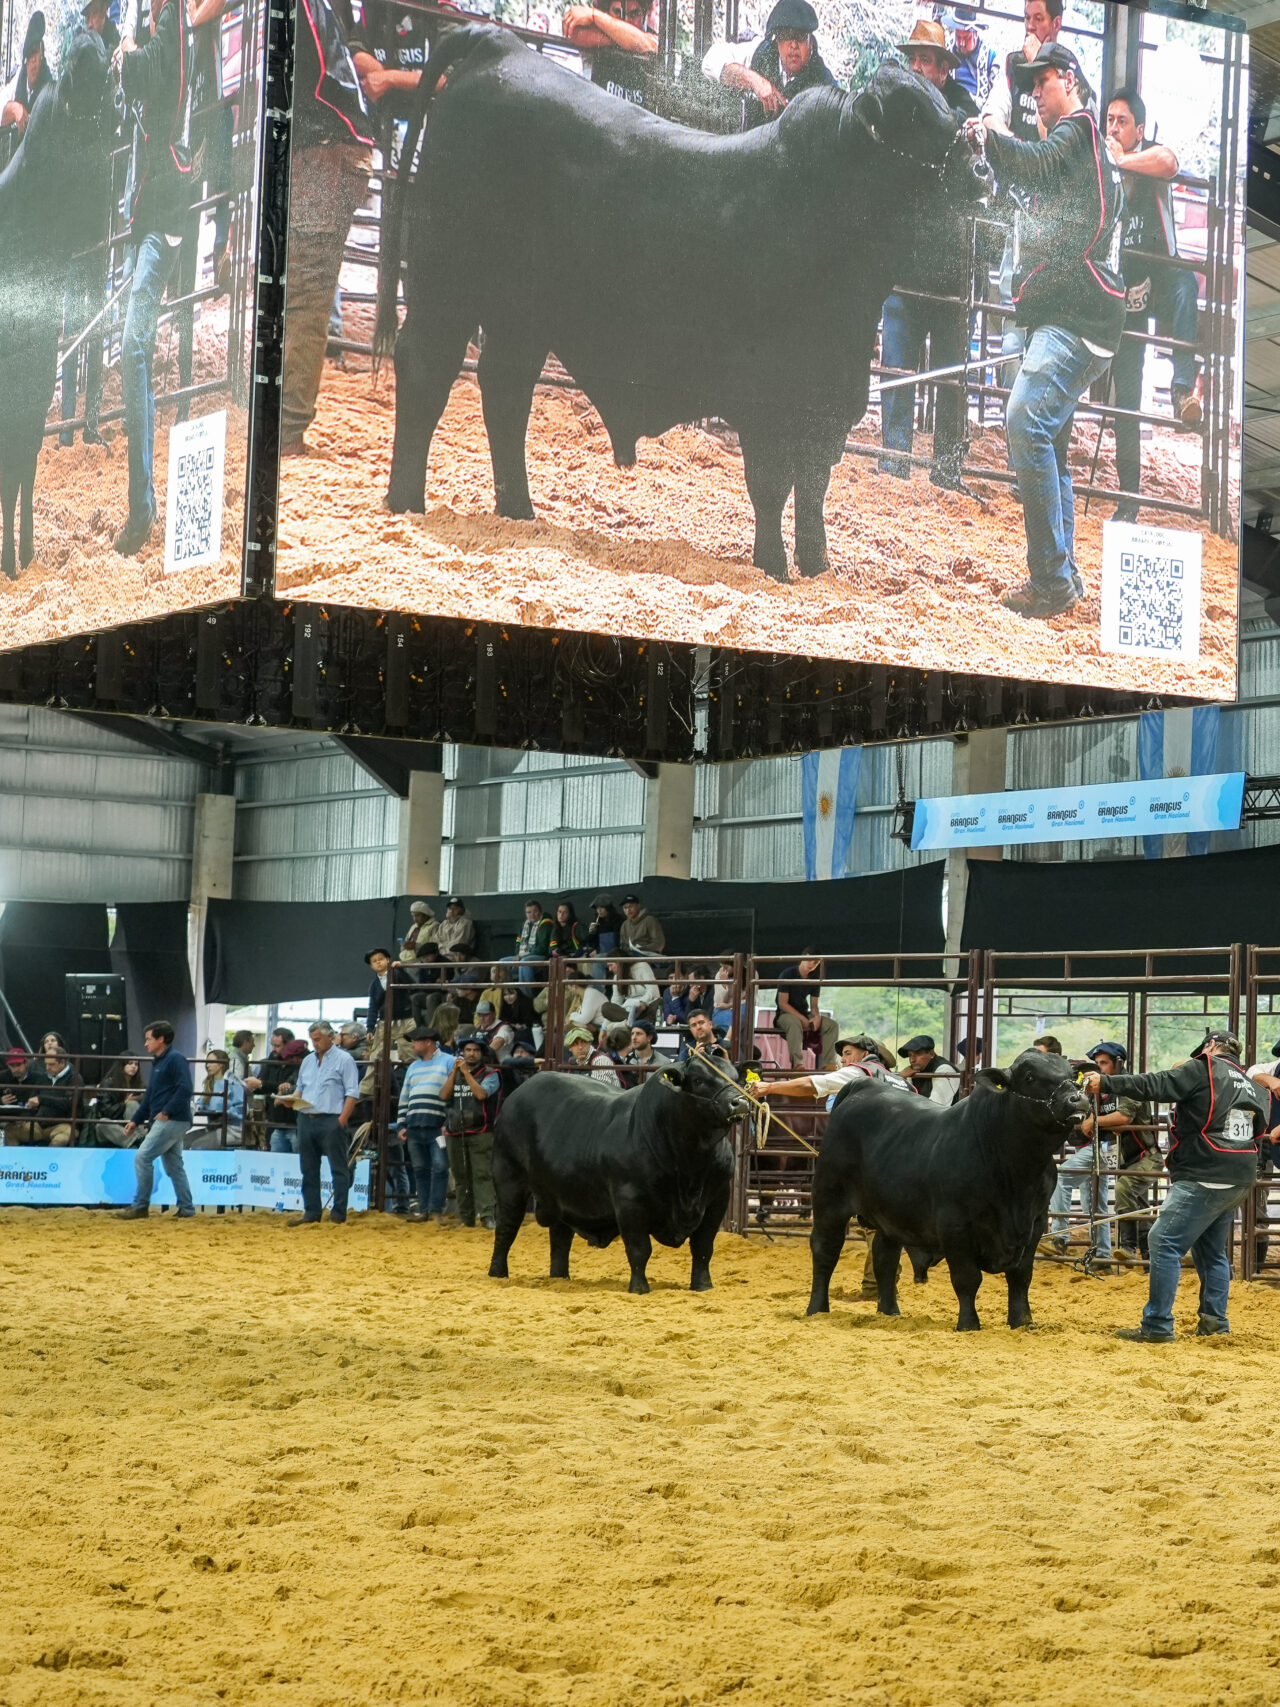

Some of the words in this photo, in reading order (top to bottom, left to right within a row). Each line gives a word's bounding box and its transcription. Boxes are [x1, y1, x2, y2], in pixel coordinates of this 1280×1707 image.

[206, 617, 217, 625] 49
[1098, 805, 1128, 817] BRANGUS
[1149, 801, 1182, 813] BRANGUS
[998, 813, 1027, 824] BRANGUS
[1047, 809, 1077, 820] BRANGUS
[950, 817, 979, 827] BRANGUS
[1233, 1123, 1249, 1137] 317
